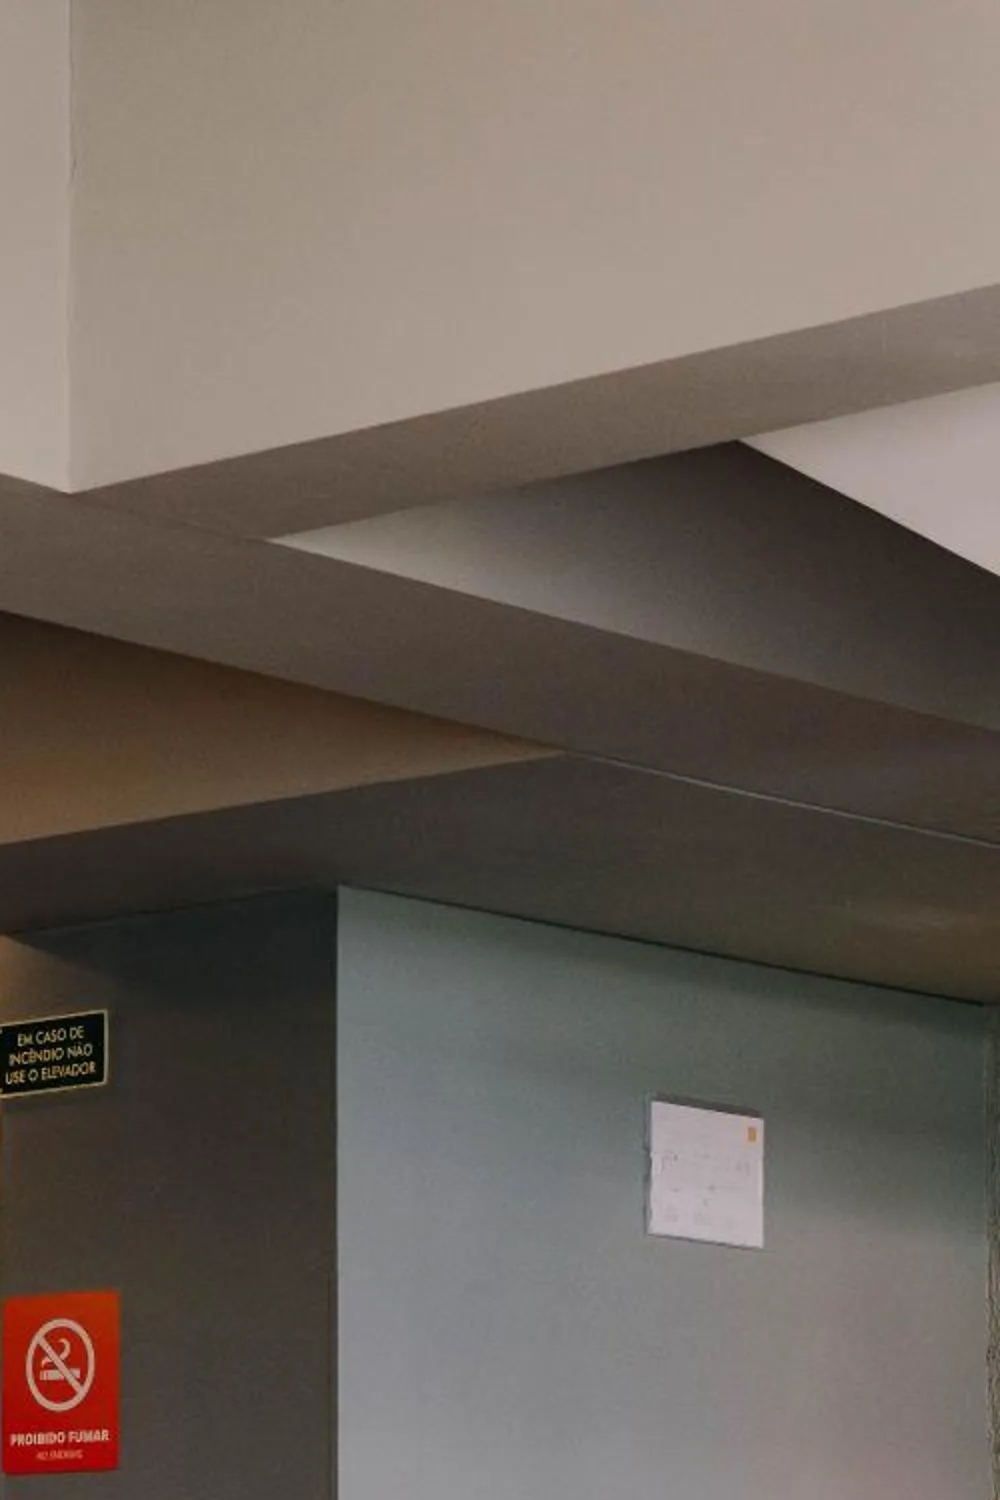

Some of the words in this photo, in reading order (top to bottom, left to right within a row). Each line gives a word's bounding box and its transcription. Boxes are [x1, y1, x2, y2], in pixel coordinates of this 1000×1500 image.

[17, 1033, 33, 1047] EM
[35, 1028, 67, 1044] CASO
[69, 1026, 84, 1040] DE
[9, 1047, 65, 1067] INCÊNDIO
[67, 1041, 93, 1059] NÃO
[5, 1069, 26, 1085] USE
[27, 1068, 39, 1082] O
[41, 1061, 96, 1081] ELEVADOR
[10, 1431, 66, 1447] PROIBIDO
[67, 1429, 109, 1444] FUMAR
